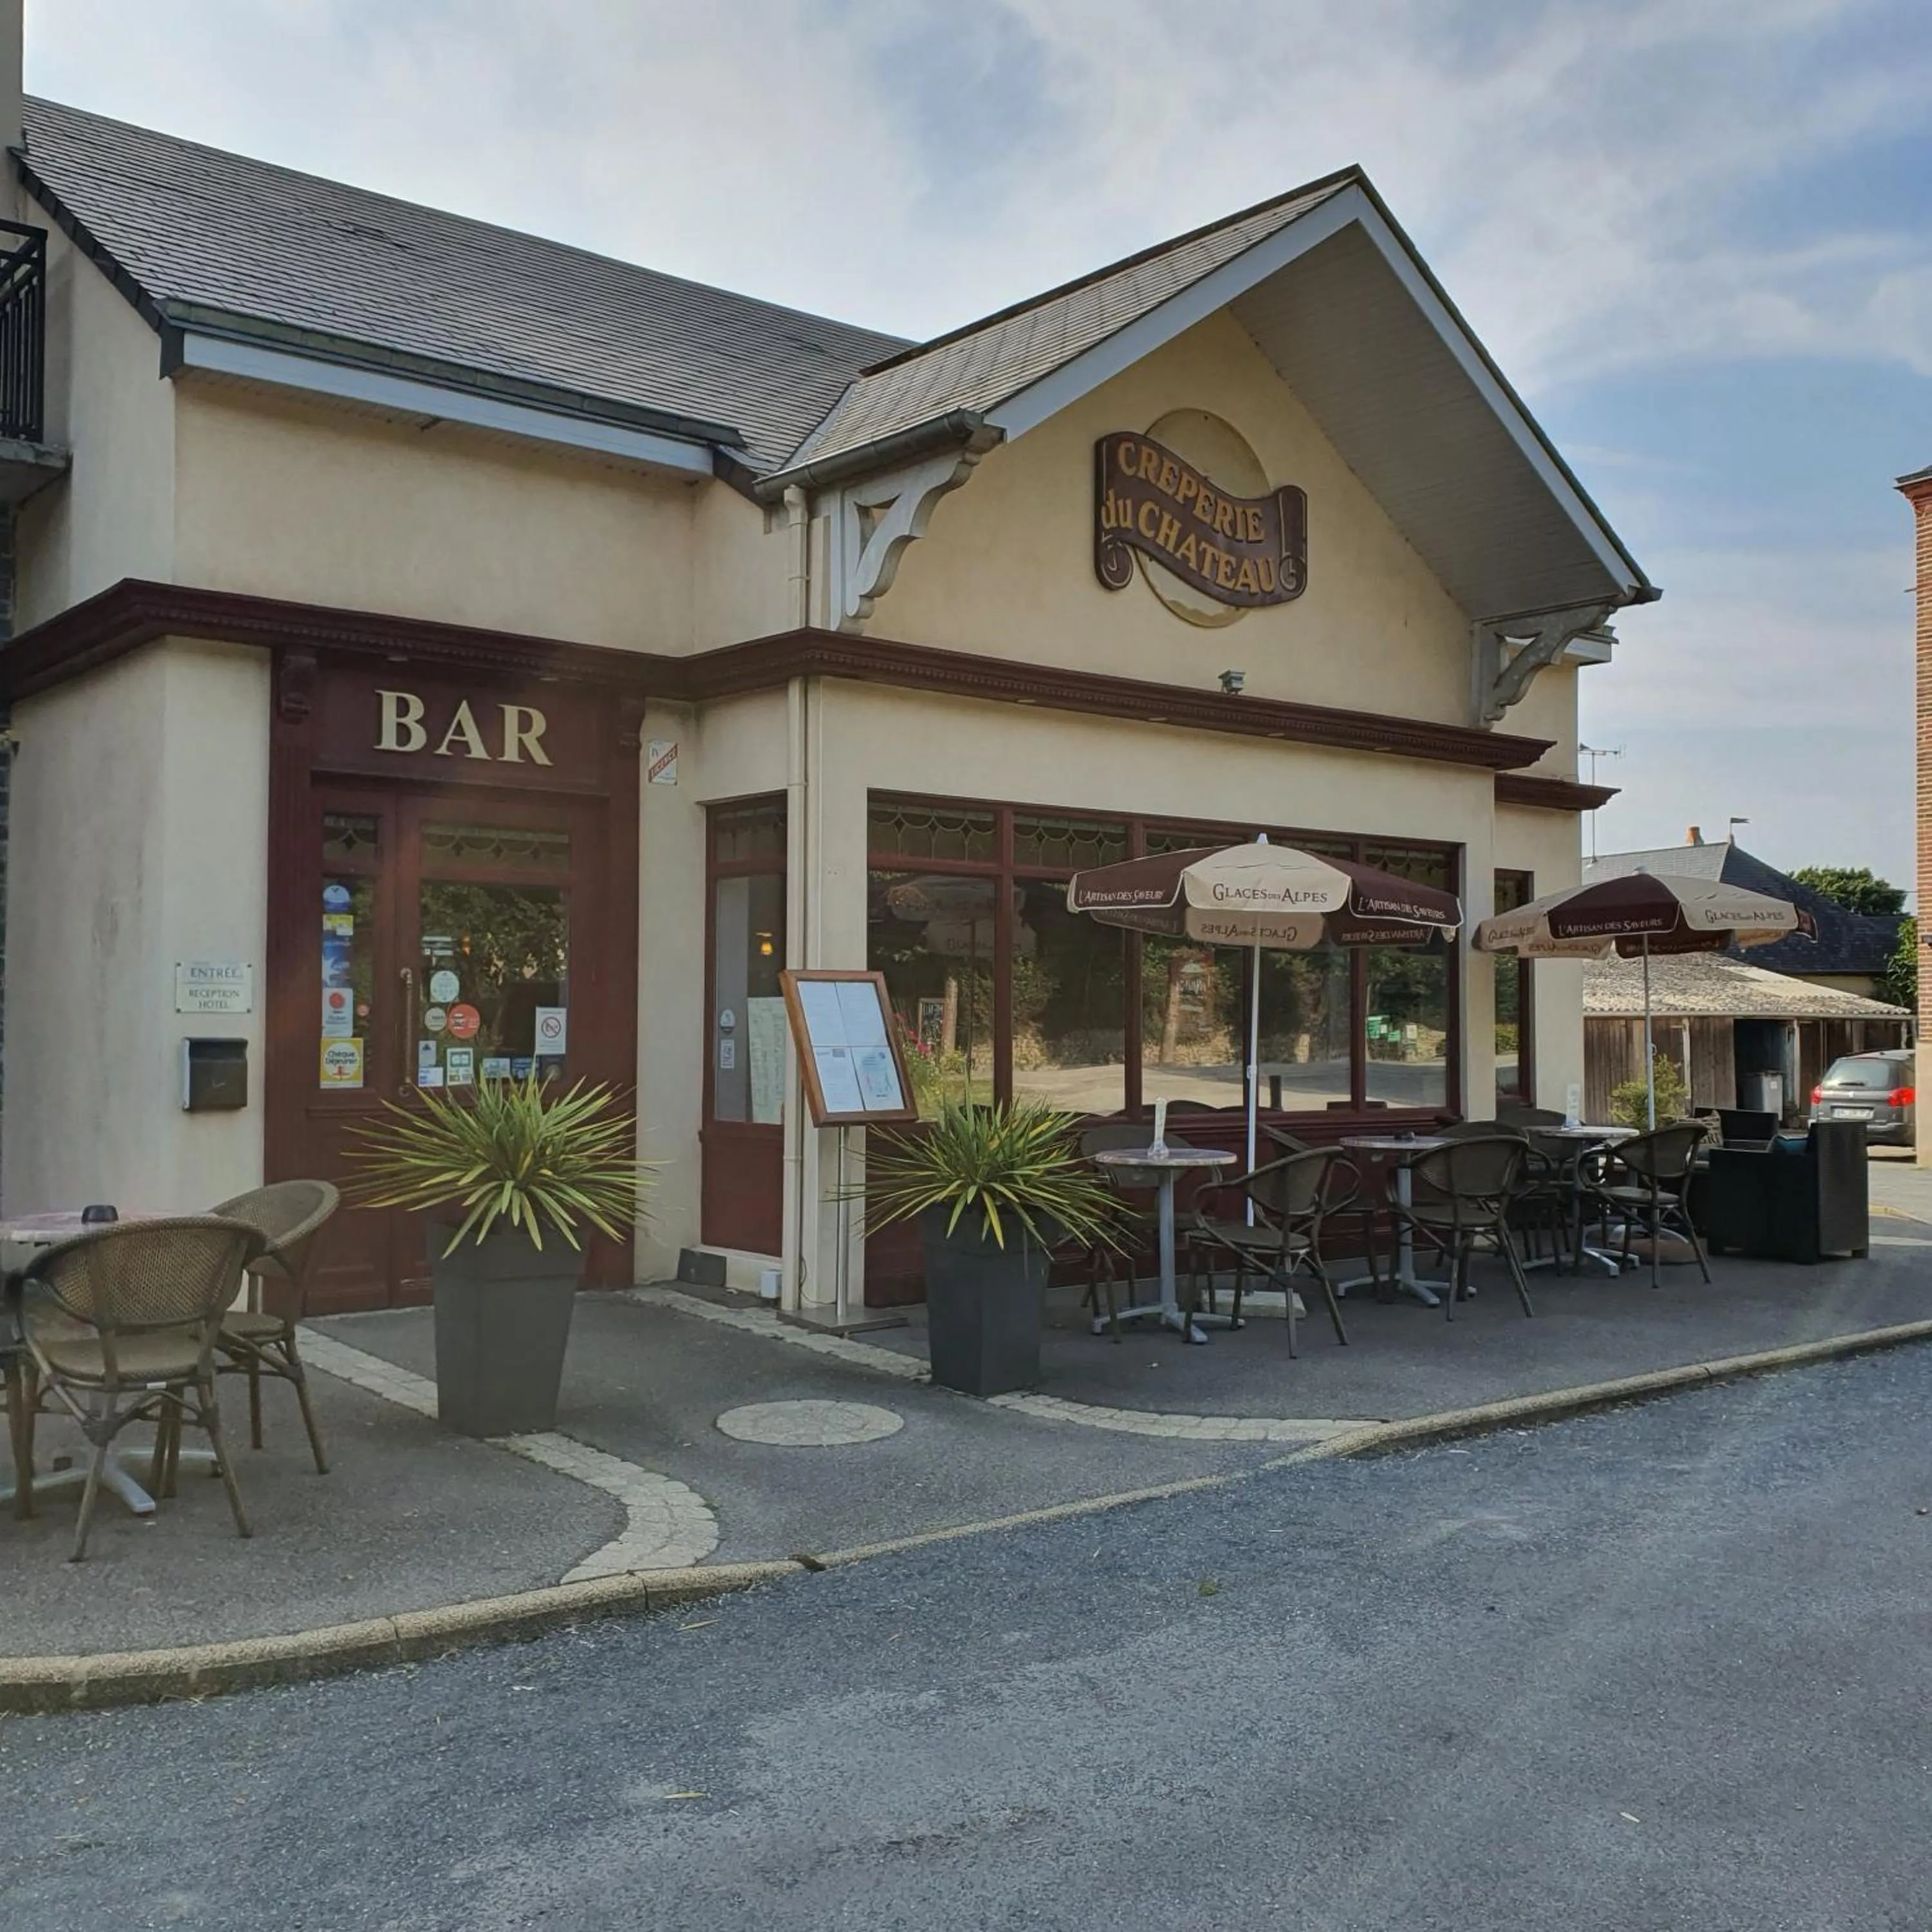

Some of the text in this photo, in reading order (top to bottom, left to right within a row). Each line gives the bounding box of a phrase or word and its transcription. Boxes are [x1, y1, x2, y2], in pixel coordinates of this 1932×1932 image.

[1118, 441, 1265, 543] CREPERIE
[1102, 489, 1276, 594] du CHATEAU
[374, 690, 554, 766] BAR
[1213, 884, 1268, 901] GLACES
[1282, 889, 1328, 904] ALPES
